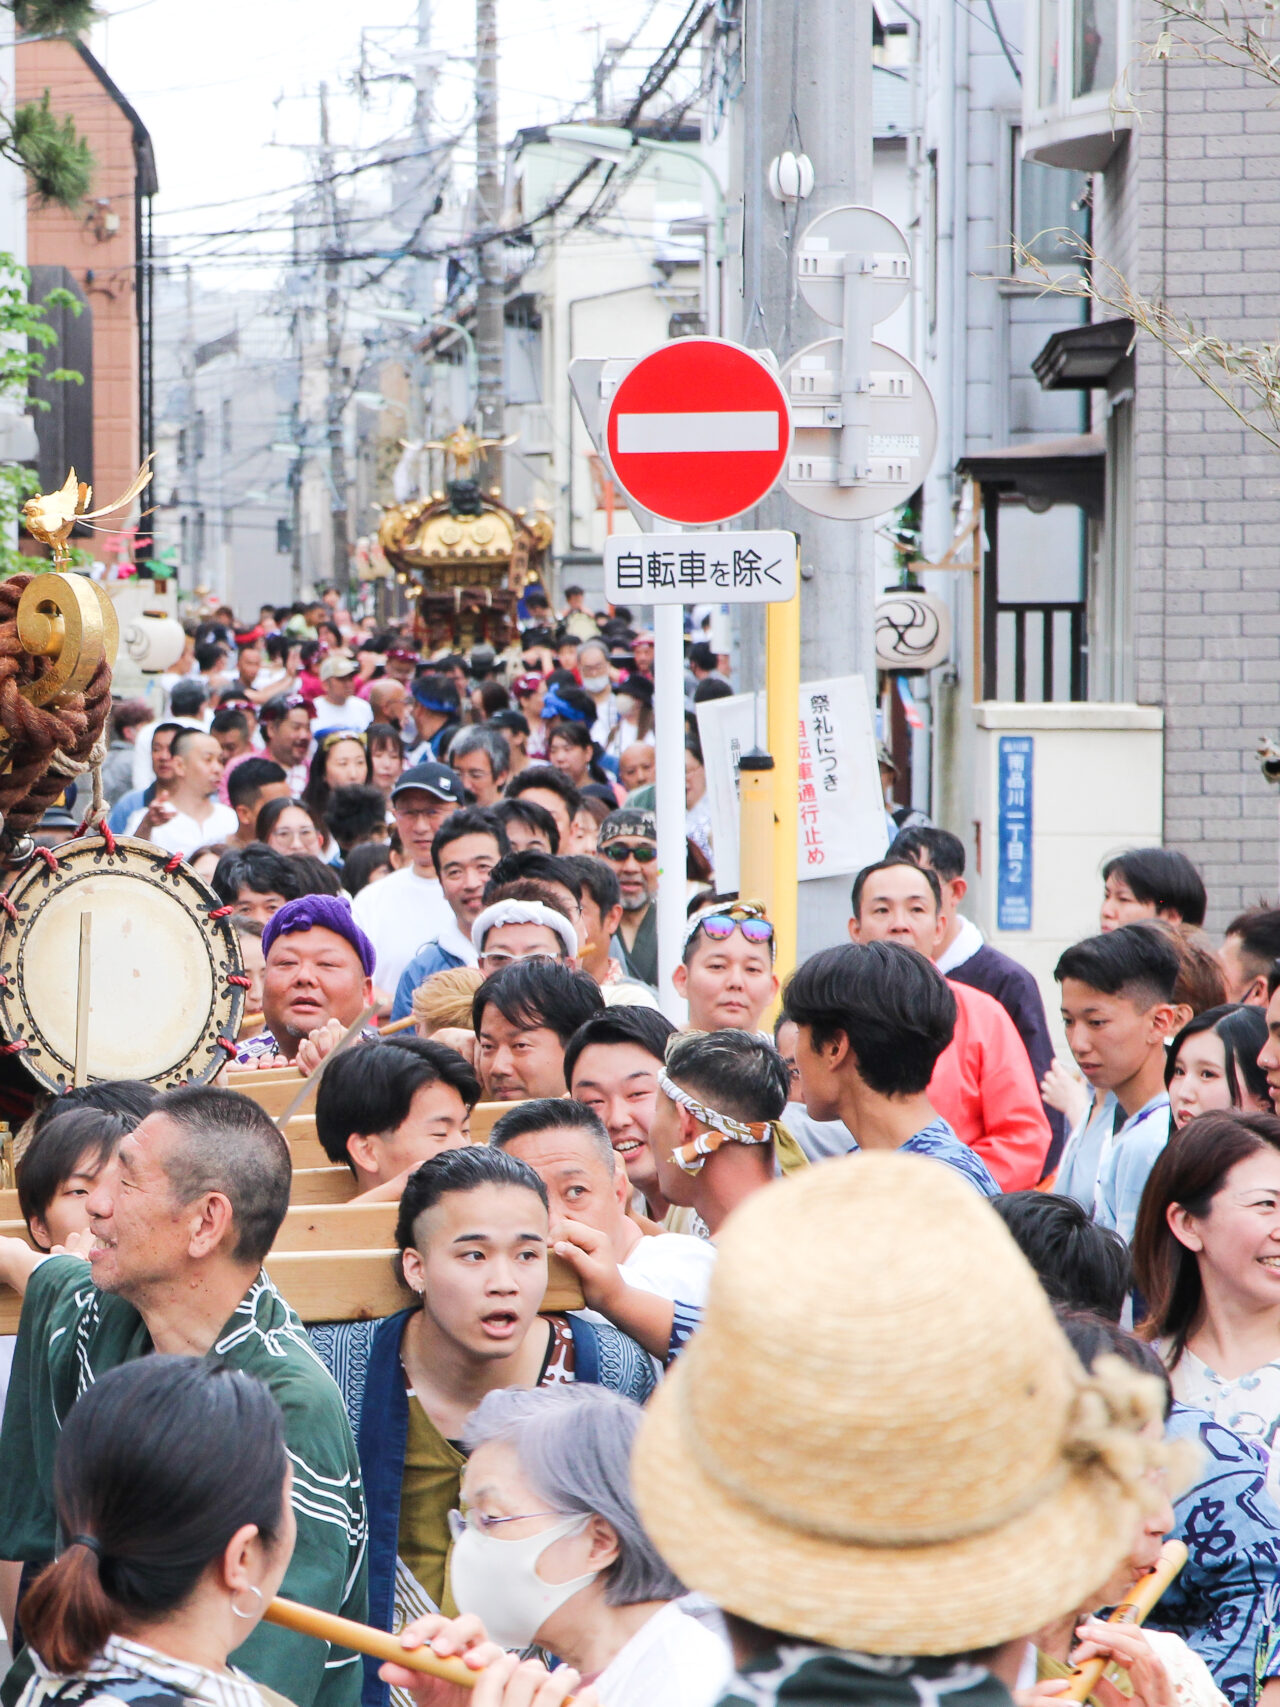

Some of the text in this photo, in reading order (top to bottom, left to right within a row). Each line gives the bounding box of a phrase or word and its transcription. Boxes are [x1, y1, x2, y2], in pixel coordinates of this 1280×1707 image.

[617, 549, 783, 589] 自転車を除く
[810, 694, 838, 792] 祭礼につき
